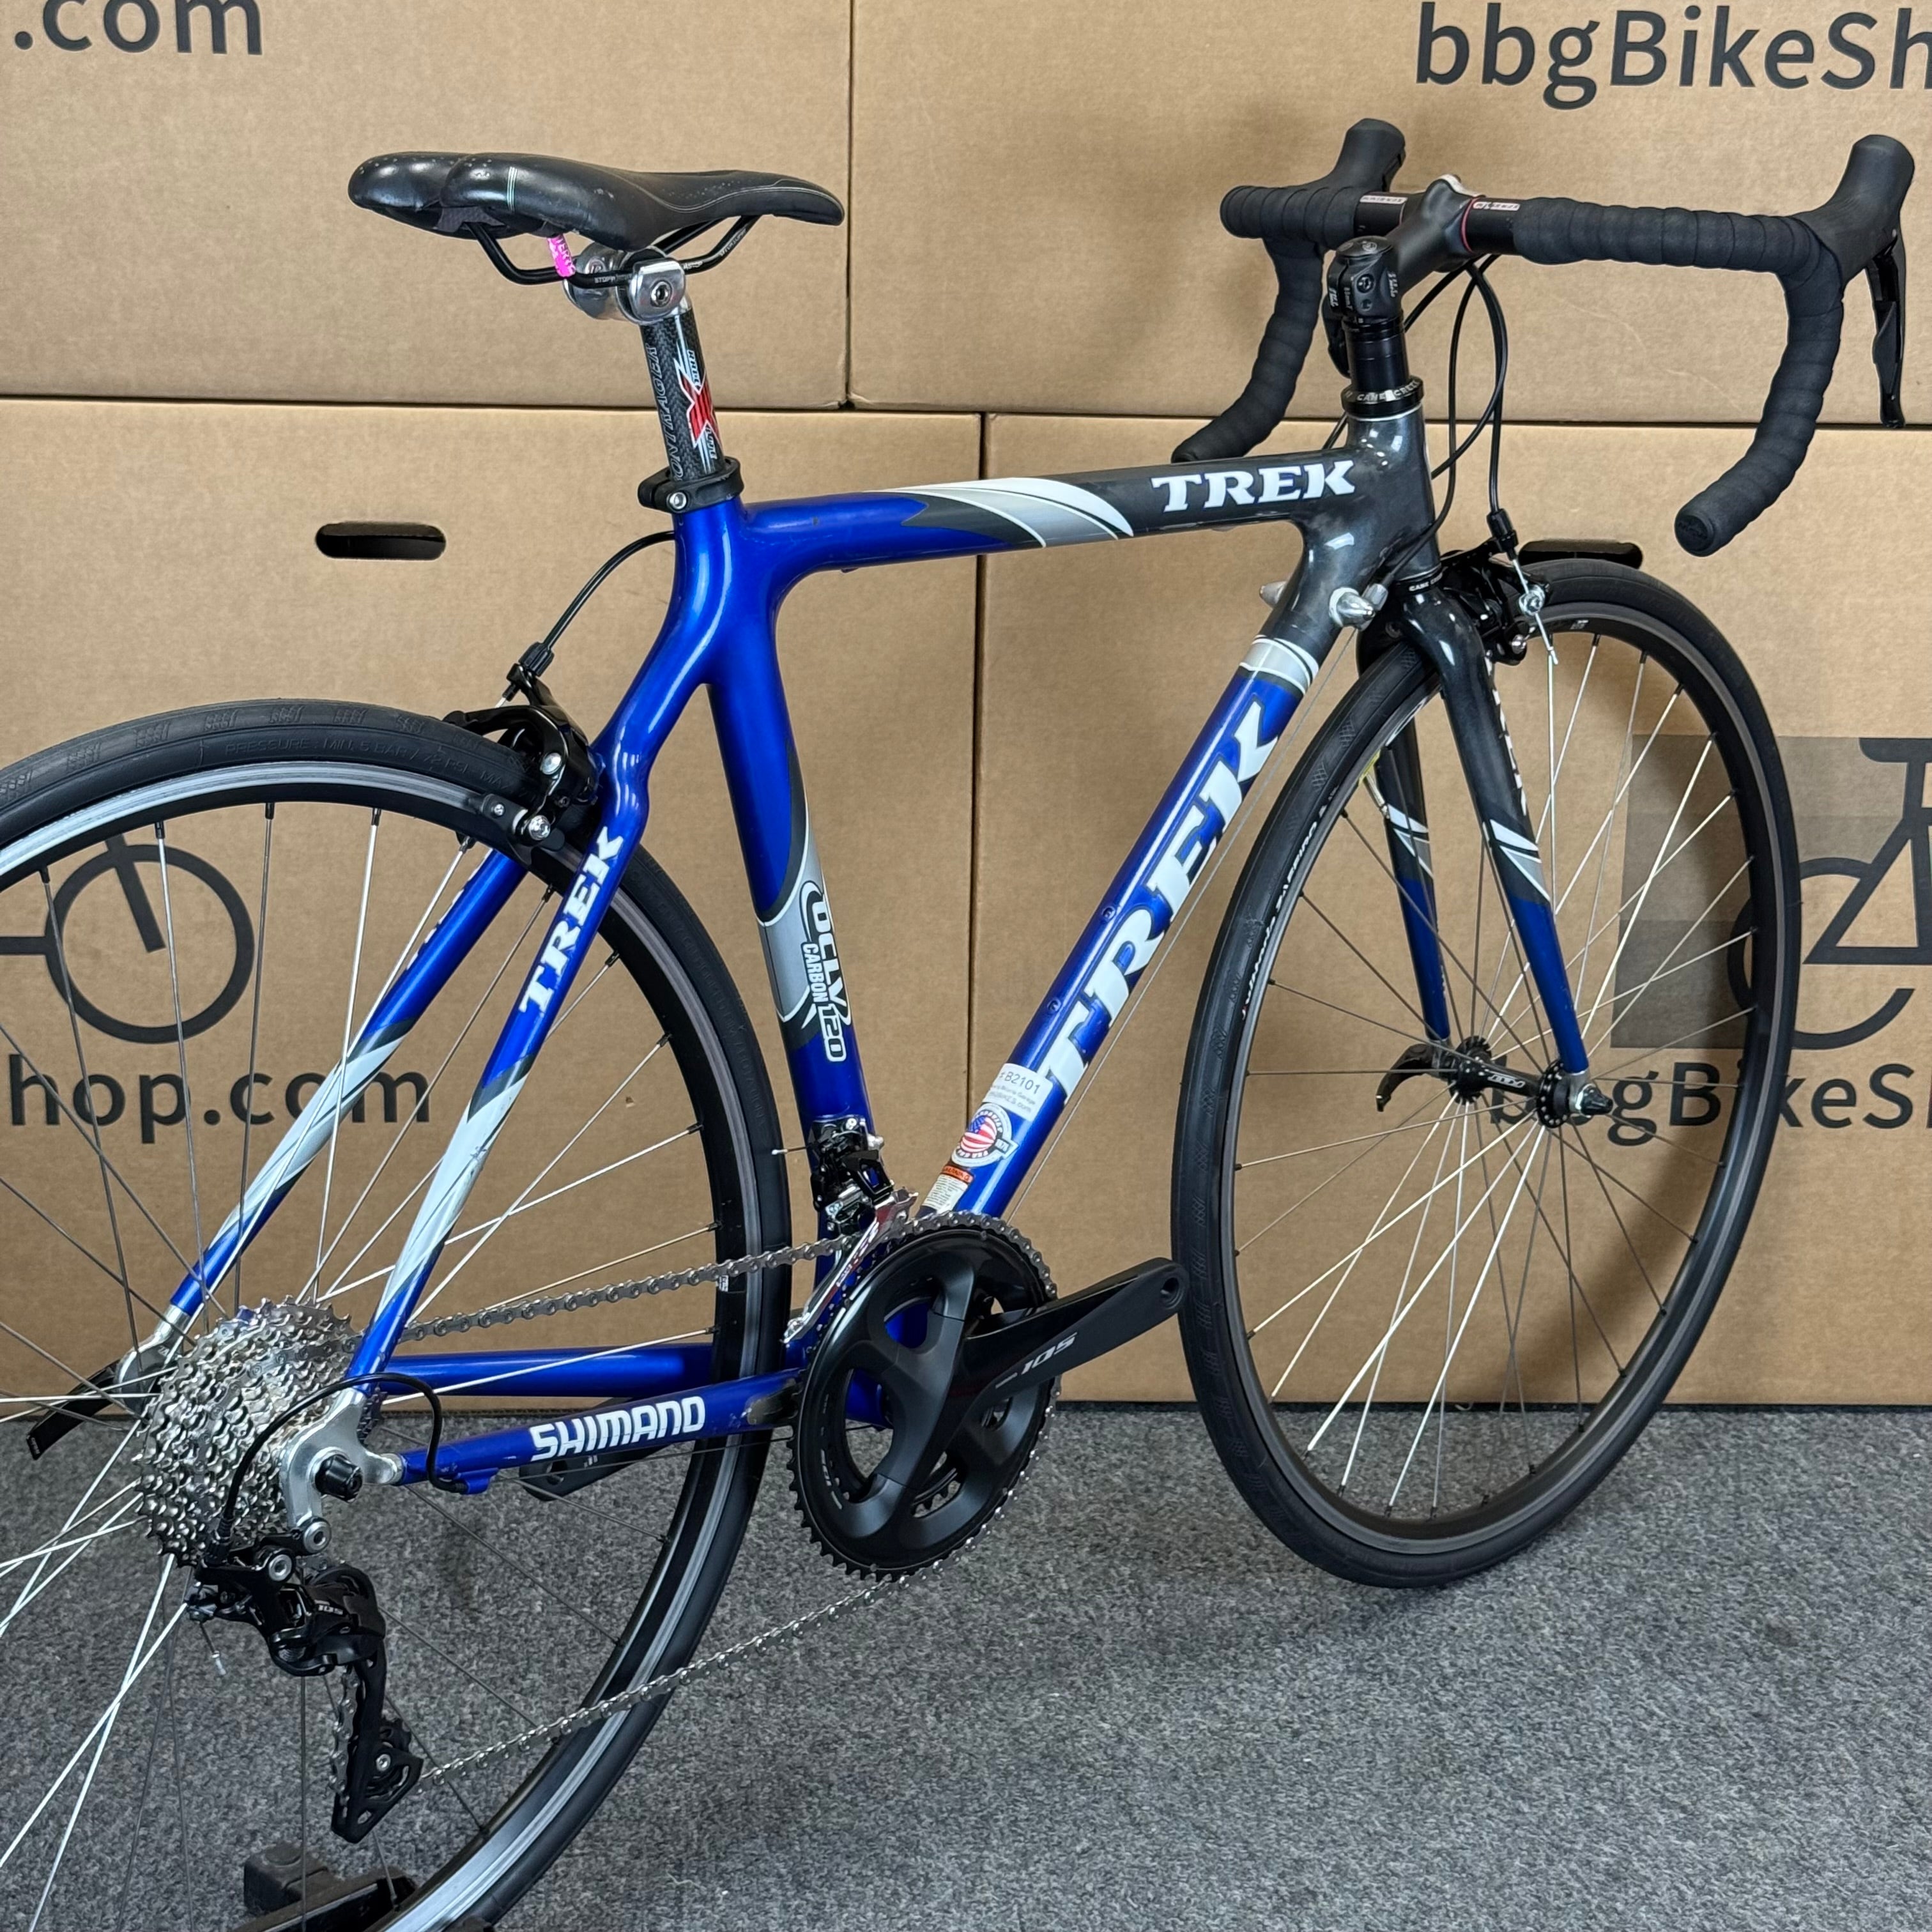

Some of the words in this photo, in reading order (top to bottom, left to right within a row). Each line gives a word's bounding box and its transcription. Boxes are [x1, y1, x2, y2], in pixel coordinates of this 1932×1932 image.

[14, 0, 263, 56] .com
[645, 345, 684, 481] ONTRAGER
[1151, 460, 1355, 512] TREK
[518, 826, 624, 1016] TREK
[1036, 700, 1278, 1105] TREK
[802, 943, 829, 1002] CARBON
[818, 1004, 847, 1062] 120
[8, 1054, 429, 1144] hop.com
[1021, 1331, 1078, 1375] 105
[529, 1396, 706, 1462] SHIMANO
